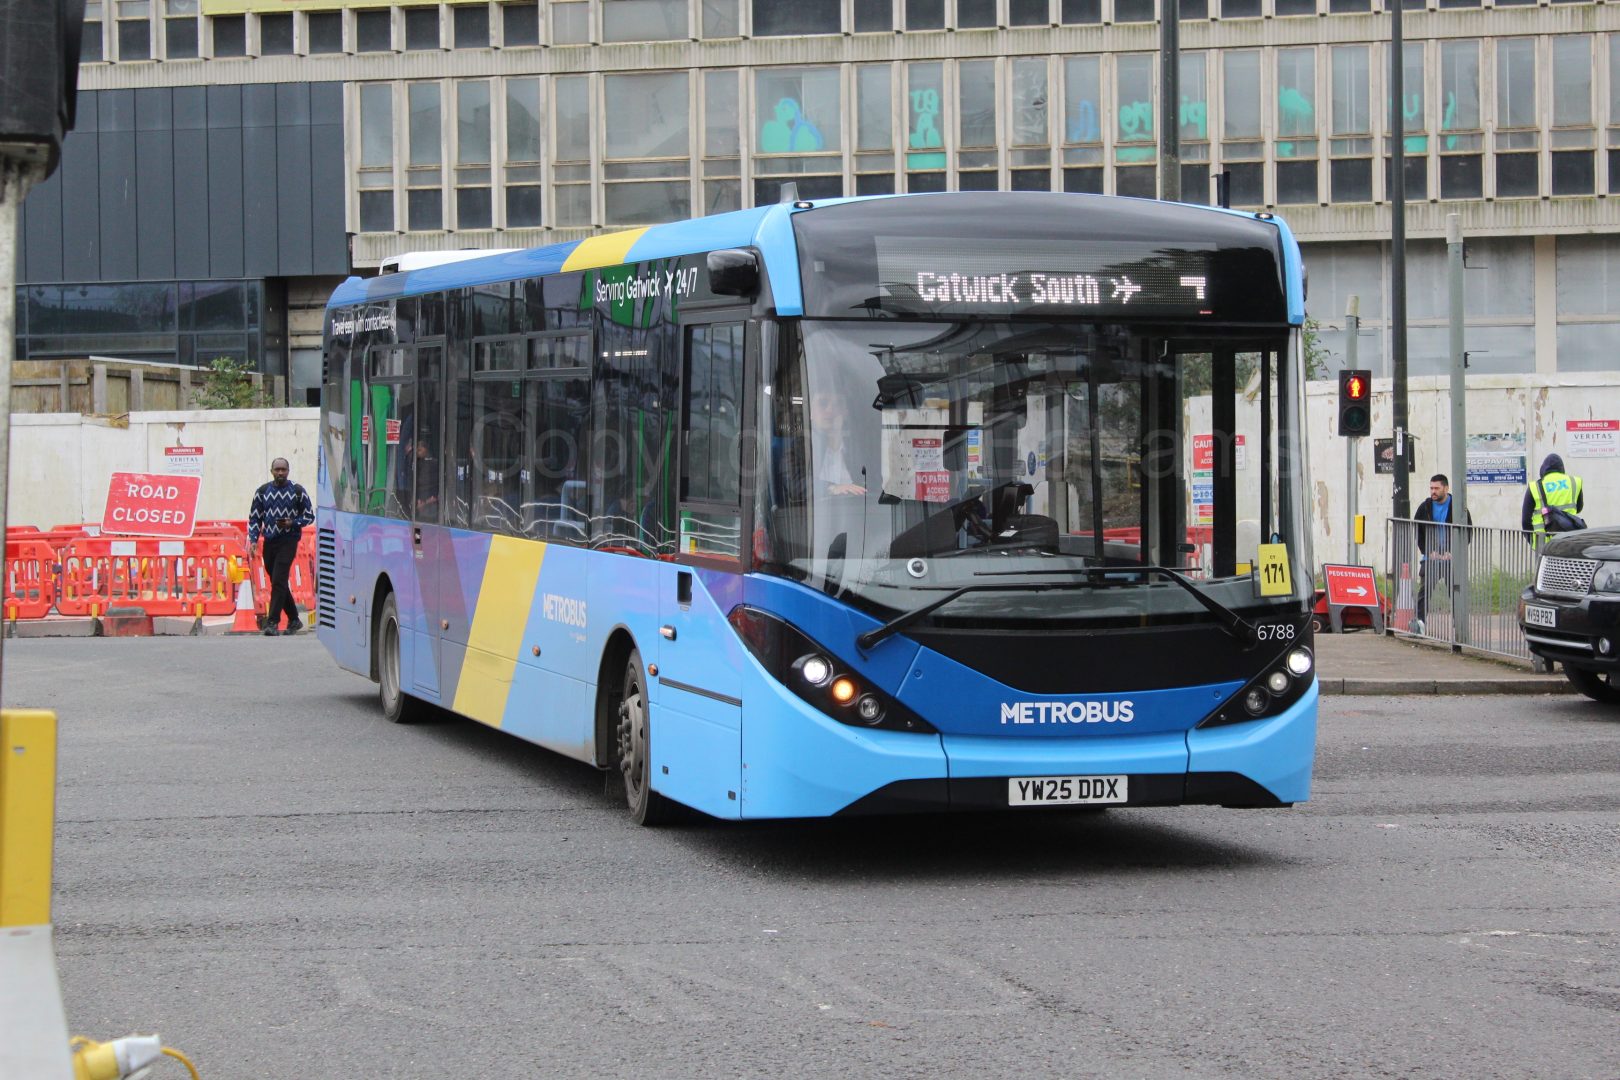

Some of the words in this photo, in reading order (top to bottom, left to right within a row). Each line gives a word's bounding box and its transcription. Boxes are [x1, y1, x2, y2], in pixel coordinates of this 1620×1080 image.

[596, 276, 624, 307] Serving
[626, 271, 660, 299] Gatwick
[676, 267, 698, 298] 24/7
[917, 272, 1020, 303] Gatwick
[1031, 274, 1100, 304] South
[1194, 440, 1213, 449] CAUT
[127, 484, 179, 500] ROAD
[1545, 479, 1569, 493] DX
[112, 507, 186, 524] CLOSED
[1264, 563, 1285, 584] 171
[1328, 570, 1371, 579] PEDESTRIANS
[543, 592, 587, 628] METROBUS
[1257, 624, 1295, 640] 6788
[1000, 700, 1134, 724] METROBUS
[1018, 779, 1072, 801] YW25
[1078, 778, 1118, 799] DDX
